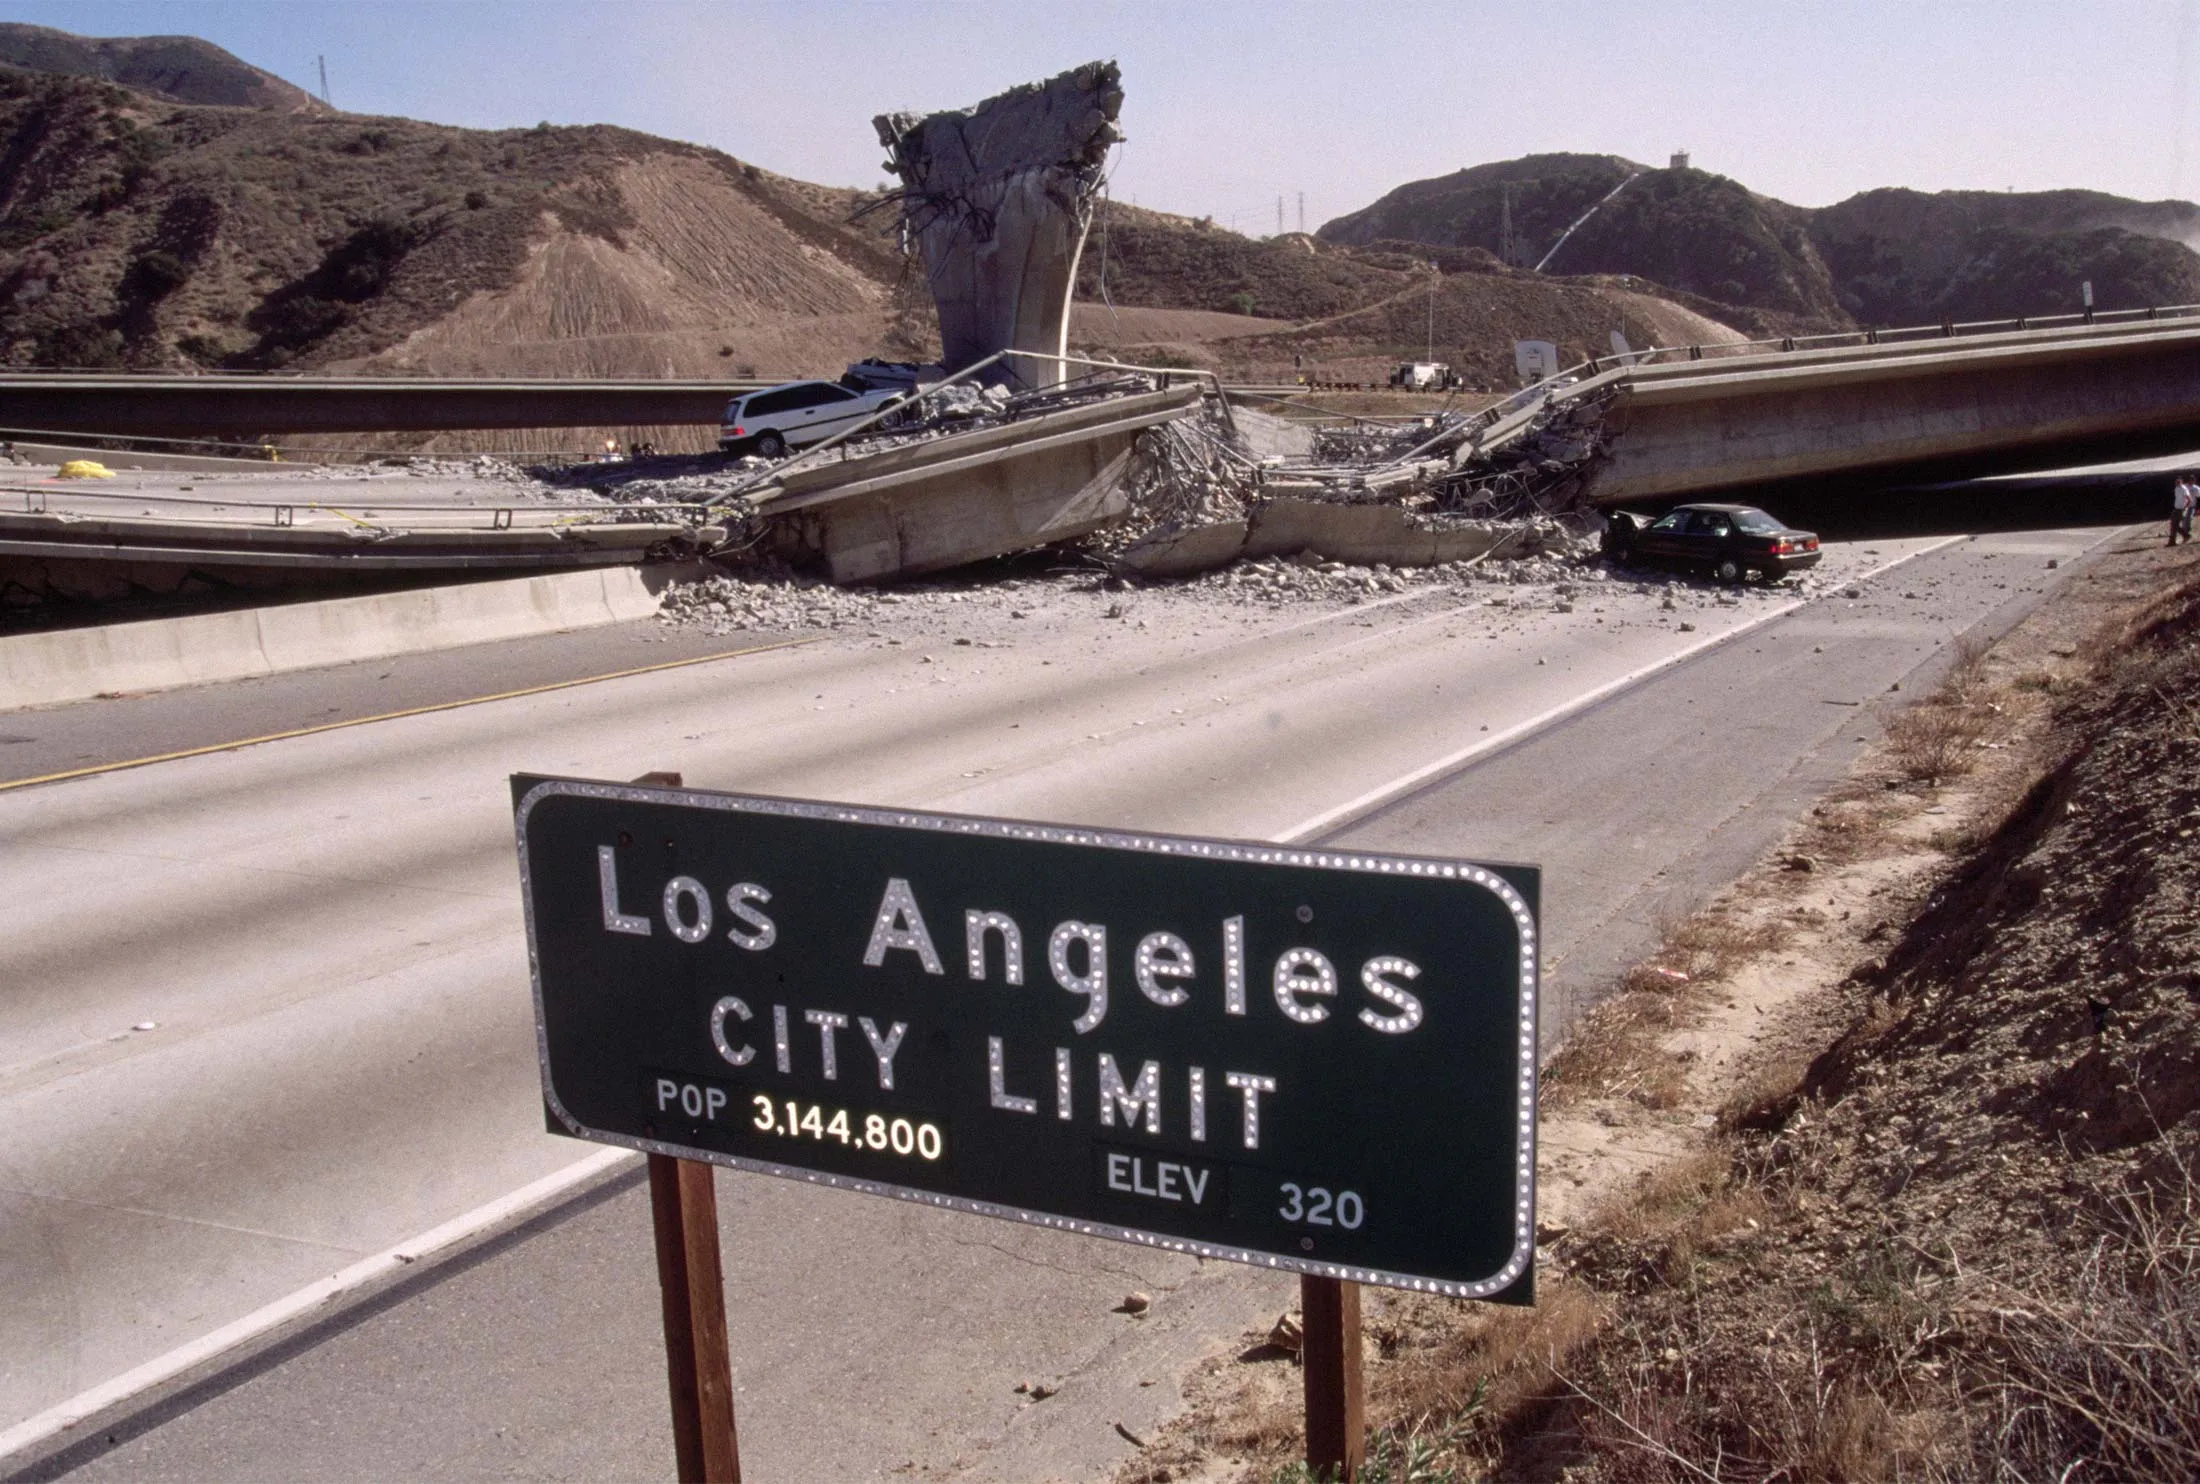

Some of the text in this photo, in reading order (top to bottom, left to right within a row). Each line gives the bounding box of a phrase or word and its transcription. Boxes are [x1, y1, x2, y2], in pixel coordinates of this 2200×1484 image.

[598, 844, 1424, 1034] Los Angeles
[657, 1079, 942, 1161] POP 3,144,800
[708, 996, 1276, 1149] CITY LIMIT
[1107, 1153, 1363, 1230] ELEV 320
